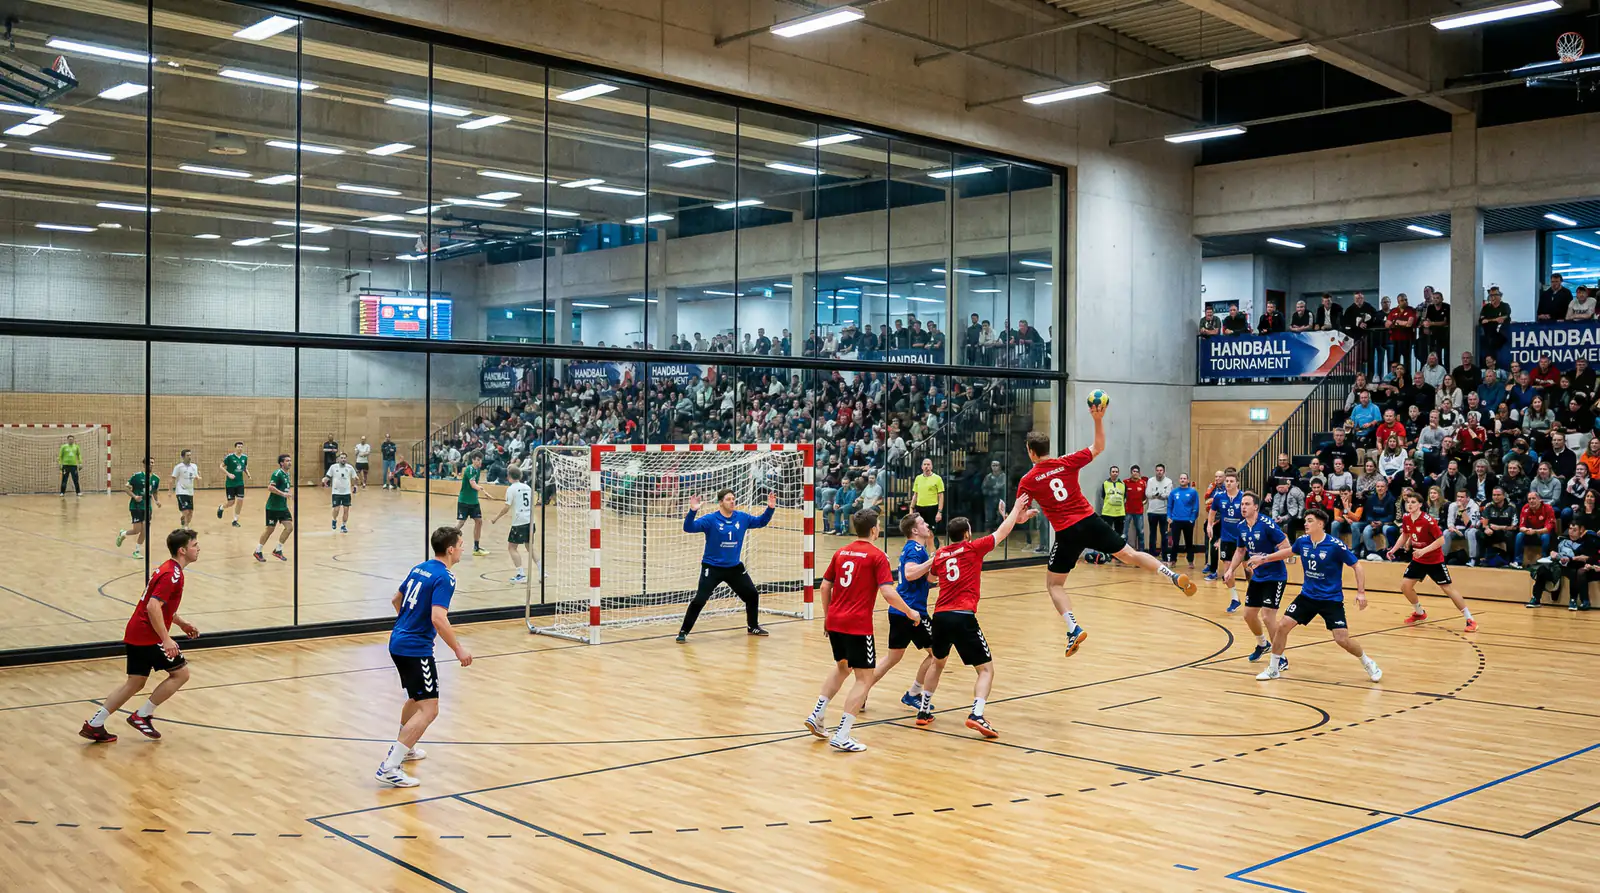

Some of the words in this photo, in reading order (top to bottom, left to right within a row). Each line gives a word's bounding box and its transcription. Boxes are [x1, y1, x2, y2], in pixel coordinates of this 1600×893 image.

[1211, 340, 1290, 356] HANDBALL
[1510, 348, 1600, 363] TOUNAME
[652, 365, 689, 376] HANDBALL
[1210, 357, 1291, 370] TOURNAMENT
[574, 367, 607, 378] HANDBALL
[1049, 477, 1069, 502] 8
[522, 492, 530, 507] 5
[728, 531, 732, 541] 1
[1307, 560, 1317, 571] 12
[839, 560, 855, 588] 3
[401, 578, 423, 610] 14
